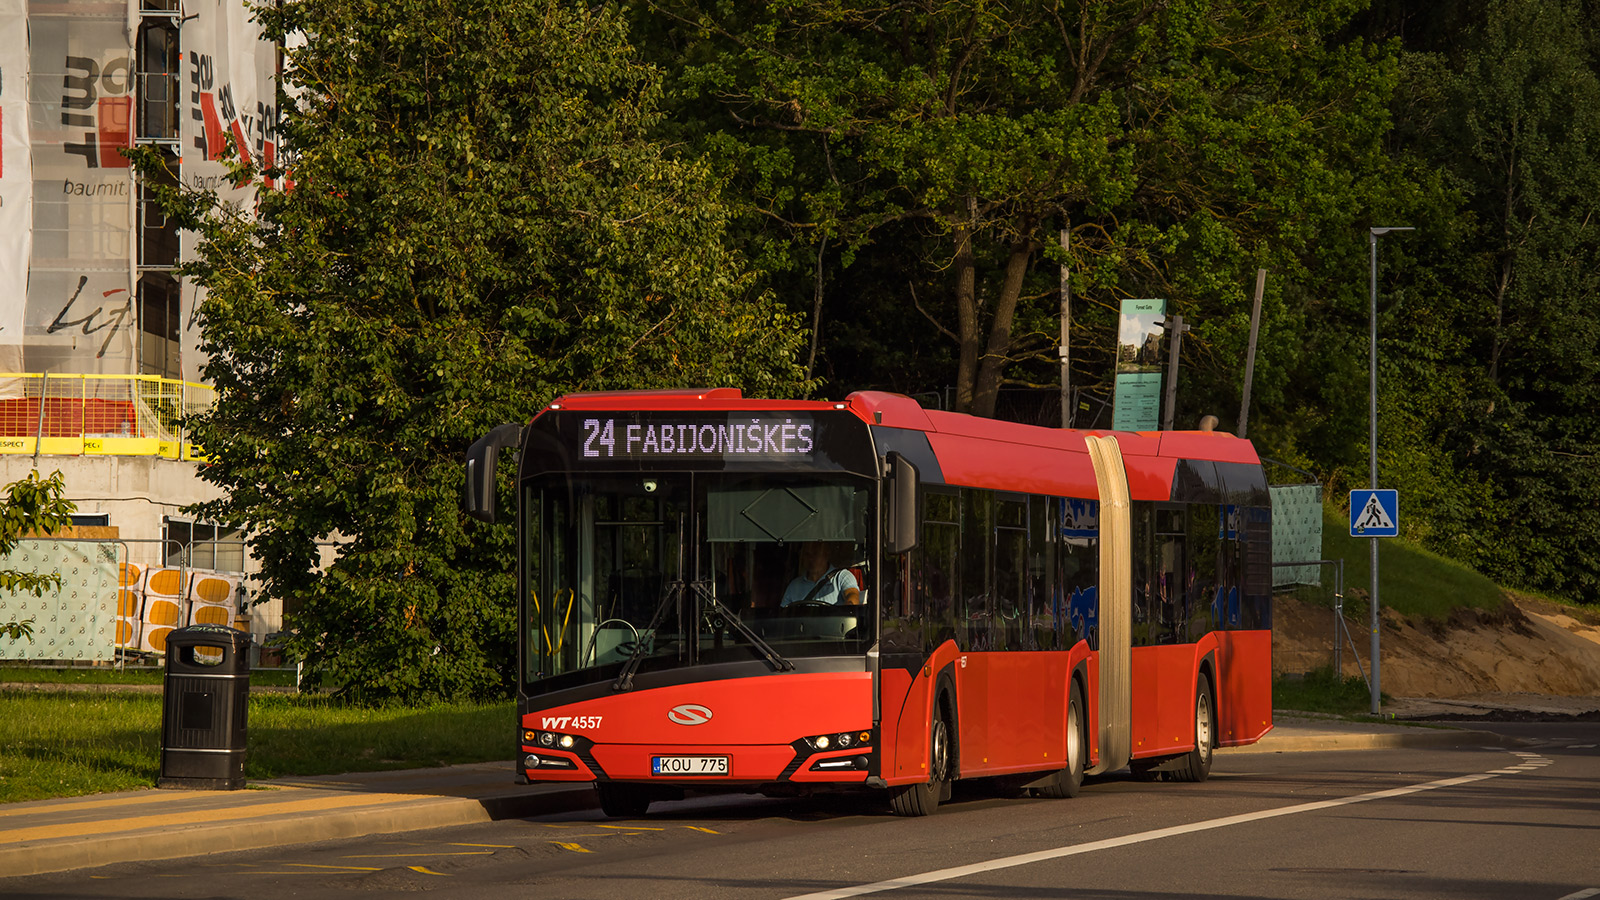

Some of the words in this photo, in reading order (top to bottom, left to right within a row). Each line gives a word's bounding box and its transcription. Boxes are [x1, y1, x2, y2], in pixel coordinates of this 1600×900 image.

[583, 418, 615, 457] 24
[626, 418, 813, 453] FABIJONIŠKĖS
[541, 716, 572, 730] VVT
[571, 716, 603, 729] 4557
[661, 758, 691, 771] KOU
[700, 758, 726, 771] 775
